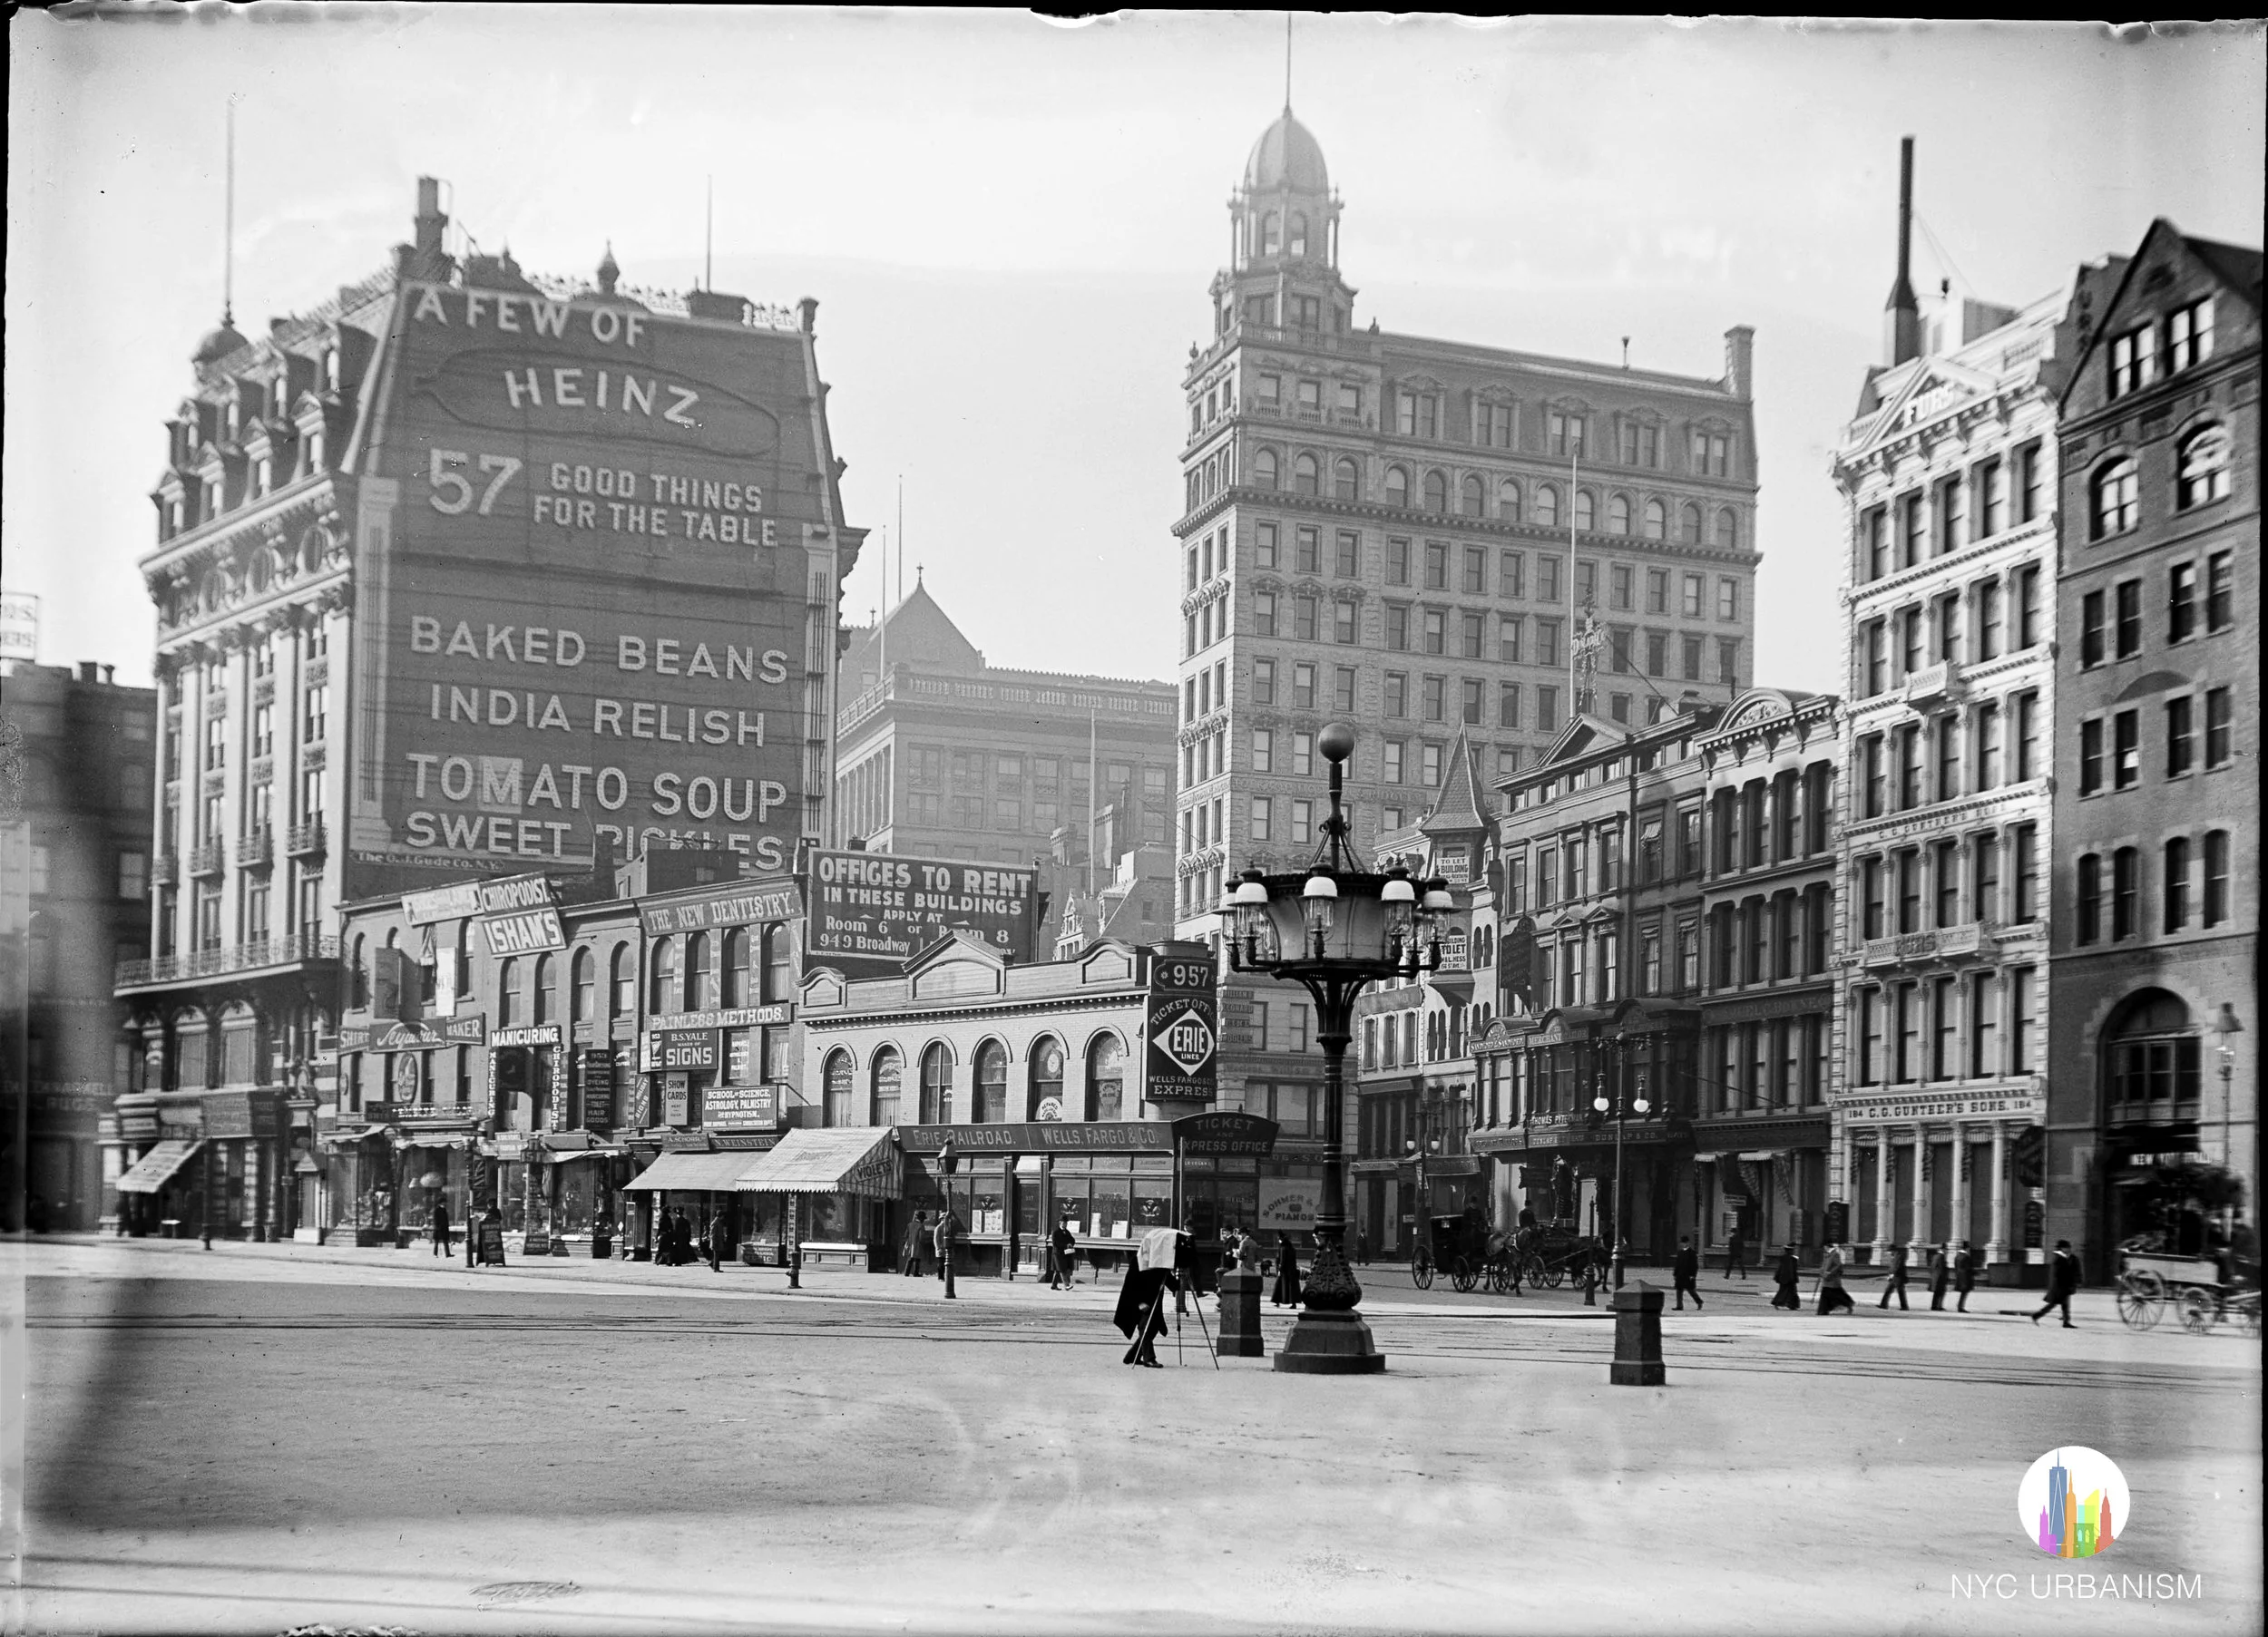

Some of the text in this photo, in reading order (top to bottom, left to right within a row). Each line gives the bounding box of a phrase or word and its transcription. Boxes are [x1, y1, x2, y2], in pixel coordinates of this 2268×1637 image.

[415, 289, 644, 347] A FEW OF
[504, 366, 700, 426] HEINZ
[428, 448, 523, 515] 57
[550, 462, 762, 513] GOOD THINGS
[533, 495, 779, 548] FOR THE TABLE
[409, 615, 789, 686] BAKED BEANS
[431, 683, 766, 747] INDIA RELISH
[406, 752, 787, 823] TOMATO SOUP
[406, 811, 784, 872] SWEET PICKLES
[358, 852, 383, 862] The
[414, 855, 451, 867] Gude
[454, 858, 474, 869] Co.
[1441, 864, 1468, 873] BUILDING
[819, 856, 1031, 898] OFFICES TO RENT
[824, 887, 1022, 915] IN THESE BUILDINGS
[648, 908, 672, 931] THE
[677, 903, 706, 928] NEW
[883, 909, 943, 923] APPLY AT
[484, 911, 562, 953] ISHAM'S
[826, 915, 1009, 943] Room 6 or Rm 8
[819, 933, 852, 949] 949
[856, 933, 911, 953] Broadway
[1441, 943, 1466, 955] TO LET
[1174, 964, 1208, 987] 957
[651, 1006, 785, 1029] PAINLESS METHODS.
[1150, 999, 1216, 1026] TICKET OFFIC
[340, 1029, 370, 1048] SHIRT
[1173, 1026, 1206, 1053] ERIE
[666, 1047, 712, 1066] SIGNS
[668, 1080, 686, 1089] SHOW
[1154, 1085, 1213, 1096] EXPRESS
[1178, 1077, 1202, 1085] FARGO
[667, 1091, 687, 1100] CARDS
[707, 1090, 735, 1099] SCHOOL
[740, 1098, 772, 1109] PALMISTRY
[1849, 1109, 1863, 1118] 184
[2014, 1101, 2031, 1109] 184
[1195, 1117, 1254, 1130] TICKET
[1530, 1115, 1553, 1125] THOMAS
[913, 1130, 943, 1145] ERIE
[1087, 1127, 1126, 1145] FARGO
[1128, 1127, 1136, 1144] &
[1139, 1127, 1159, 1144] CO.
[1595, 1132, 1632, 1142] DUNAP
[1231, 1141, 1269, 1152] OFFICE
[857, 1160, 892, 1180] VIOLETS
[1262, 1194, 1305, 1218] SOHMER
[1275, 1213, 1315, 1223] PIANOS
